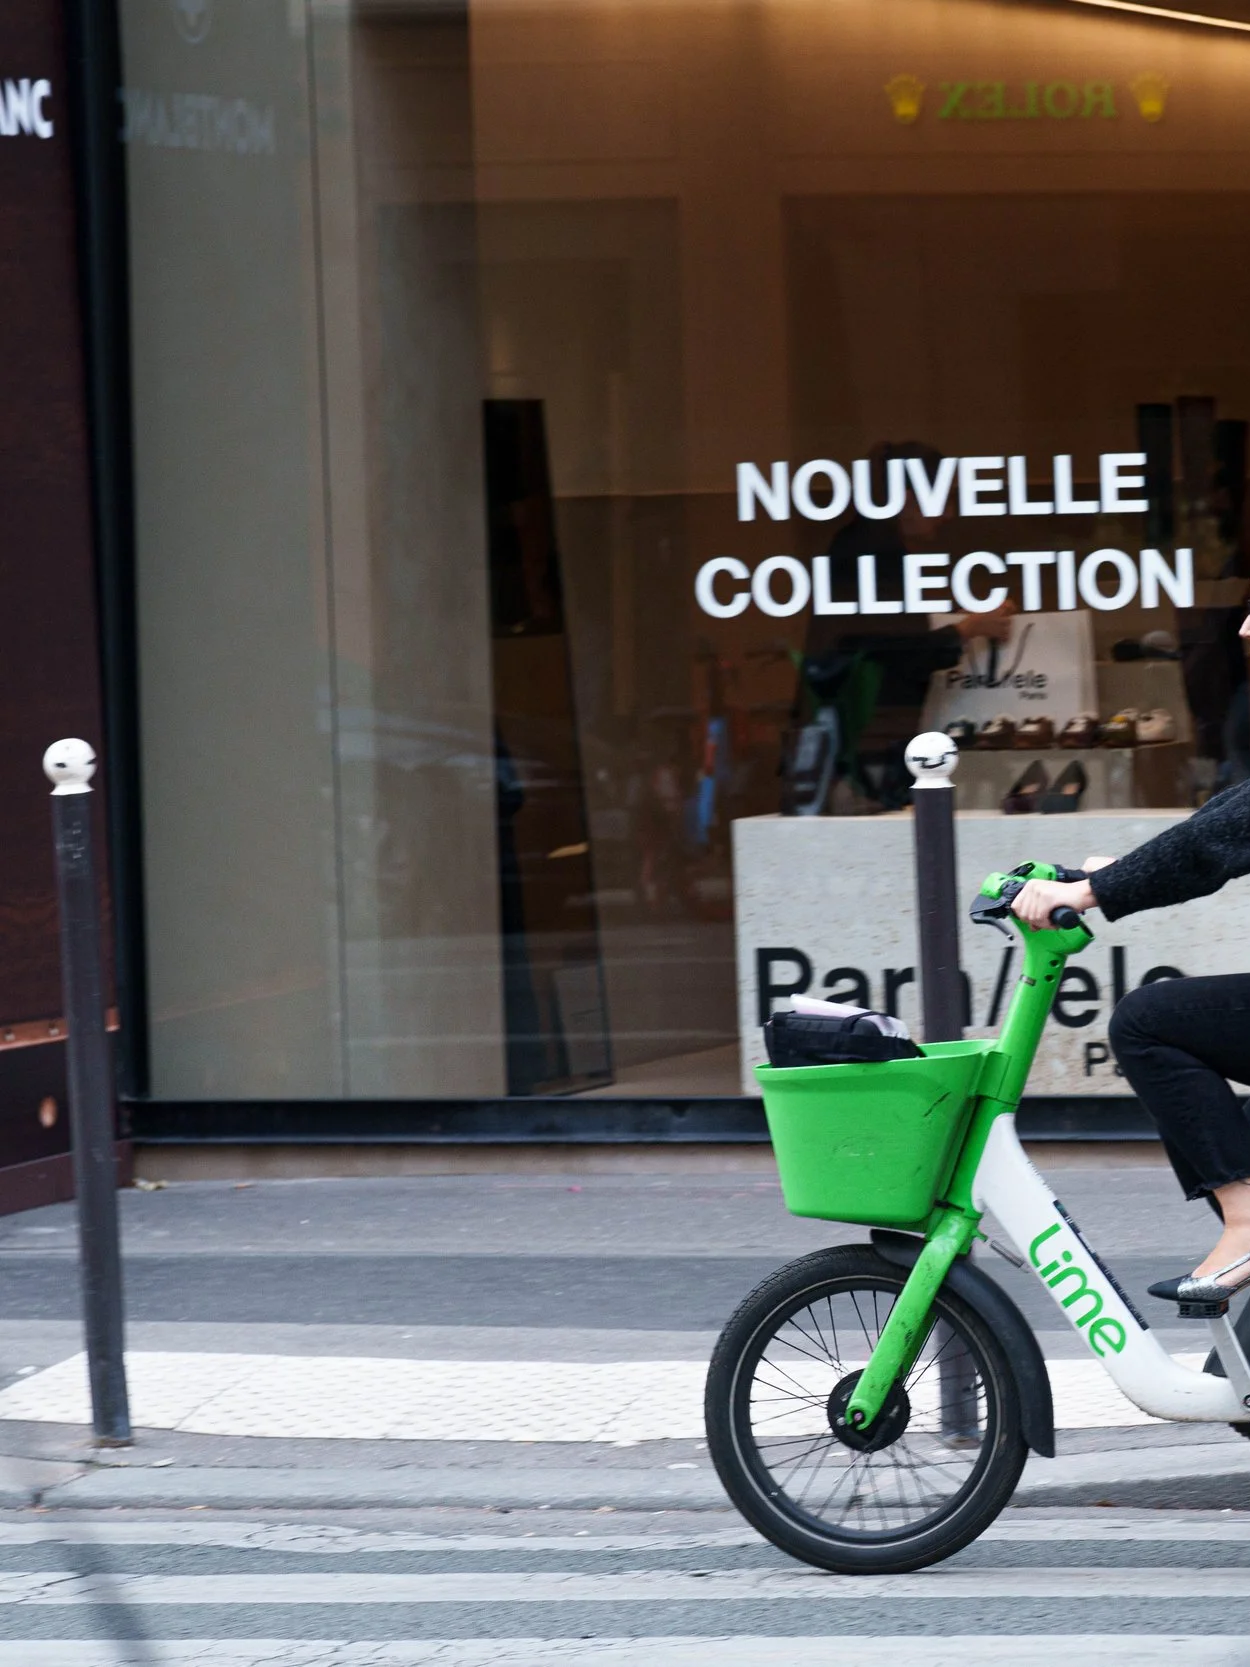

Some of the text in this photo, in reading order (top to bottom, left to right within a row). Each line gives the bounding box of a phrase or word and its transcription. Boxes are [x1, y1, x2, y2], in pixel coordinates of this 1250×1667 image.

[736, 453, 1149, 522] NOUVELLE
[695, 548, 1195, 619] COLLECTION
[1029, 1222, 1127, 1359] Lime
